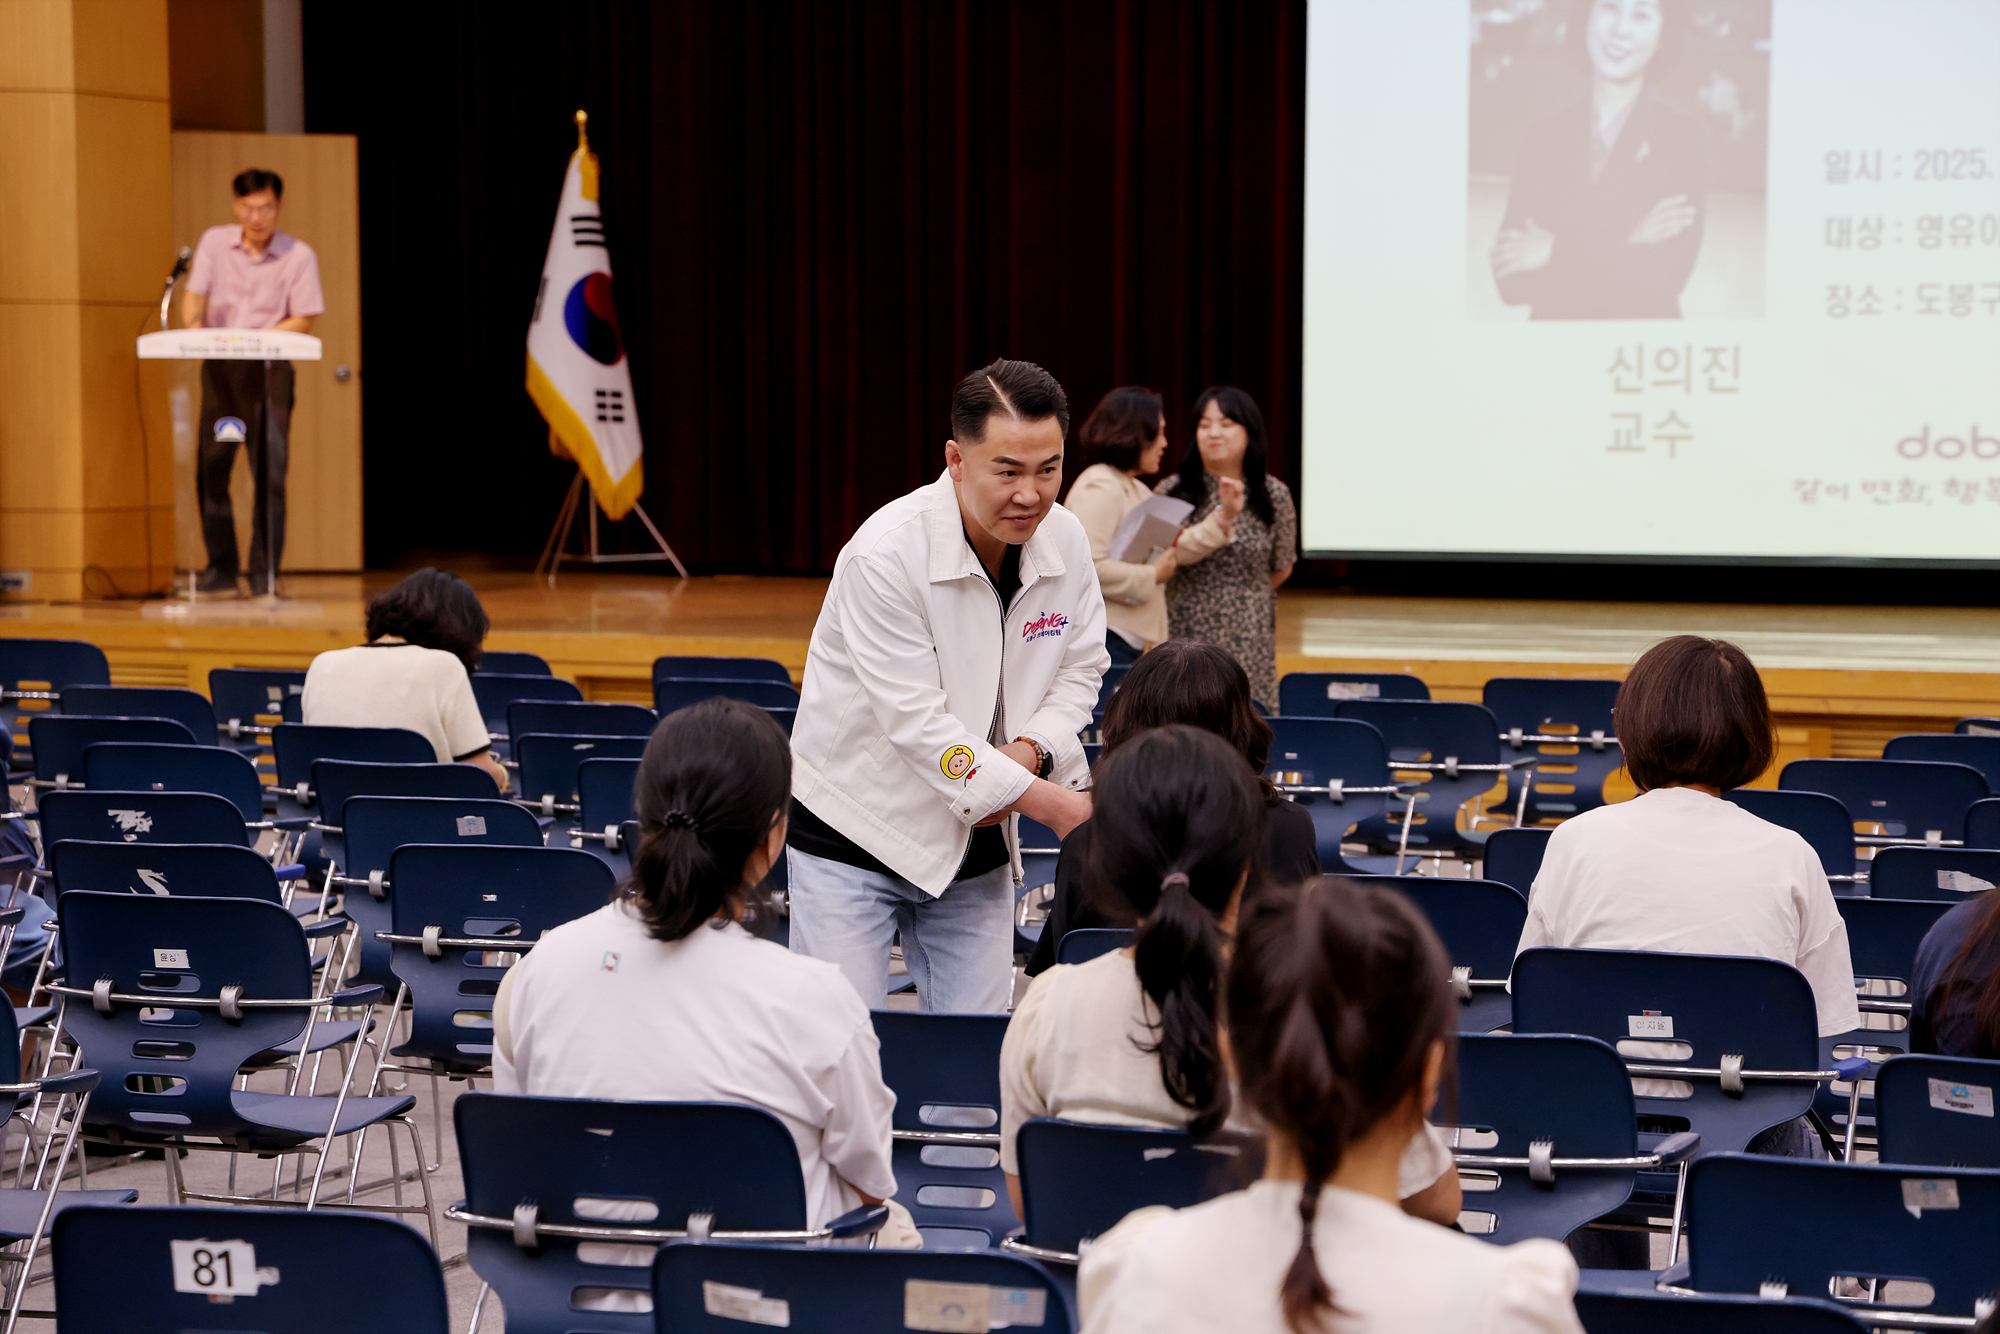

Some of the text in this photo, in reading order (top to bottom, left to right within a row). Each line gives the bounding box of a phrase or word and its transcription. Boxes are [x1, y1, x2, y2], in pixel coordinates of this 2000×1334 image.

[1824, 148, 1882, 184] 일시
[1913, 147, 1993, 181] 2025.
[1824, 215, 1884, 250] 대상
[1826, 284, 1882, 319] 장소
[1915, 281, 2000, 318] 도봉구
[1607, 342, 1742, 394] 신의진
[1605, 408, 1694, 459] 교수
[1895, 423, 2000, 460] dob
[1793, 478, 1850, 504] 같이
[193, 1249, 232, 1287] 81
